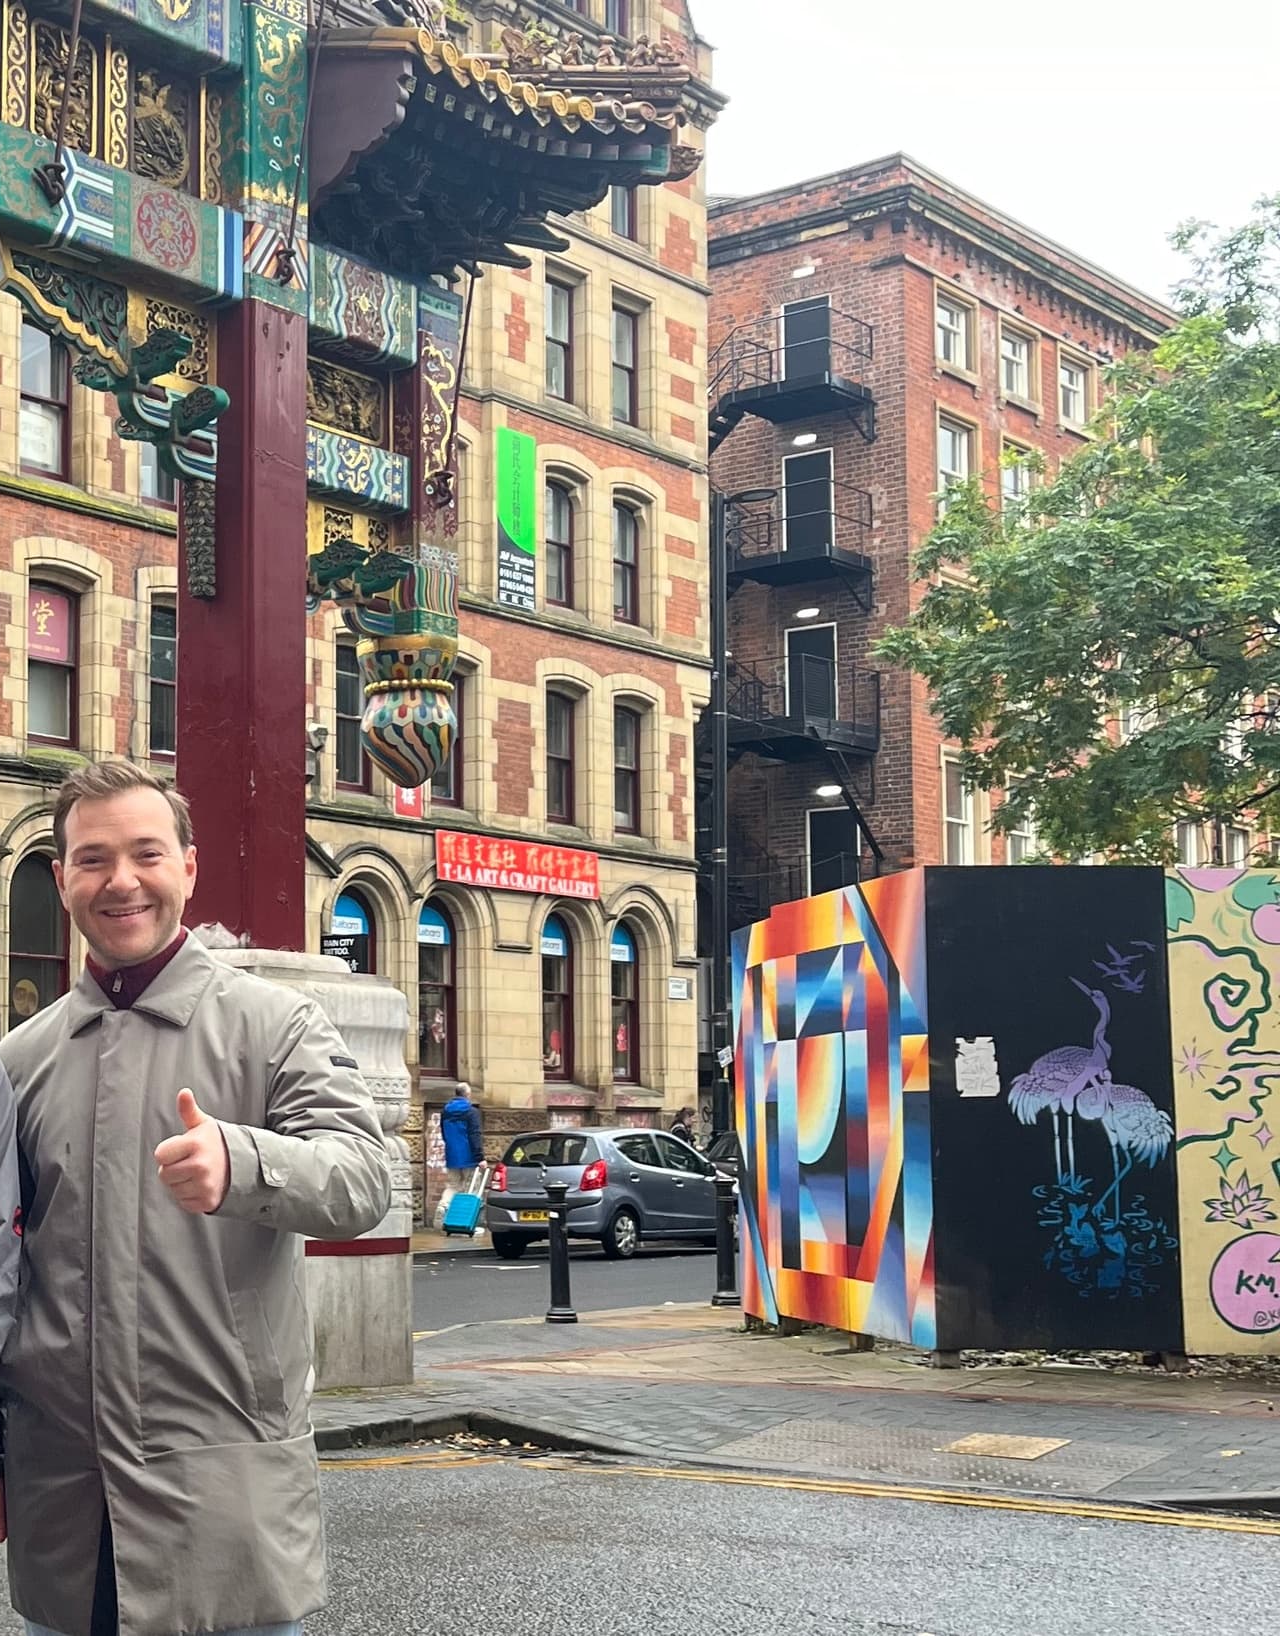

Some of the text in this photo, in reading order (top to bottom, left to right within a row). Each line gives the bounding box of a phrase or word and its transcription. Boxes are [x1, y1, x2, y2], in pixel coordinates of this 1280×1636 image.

[31, 599, 55, 636] 堂
[475, 866, 498, 886] ART
[500, 869, 509, 887] &
[510, 871, 547, 893] CRAFT
[548, 876, 595, 898] GALLERY
[339, 938, 354, 946] CITY
